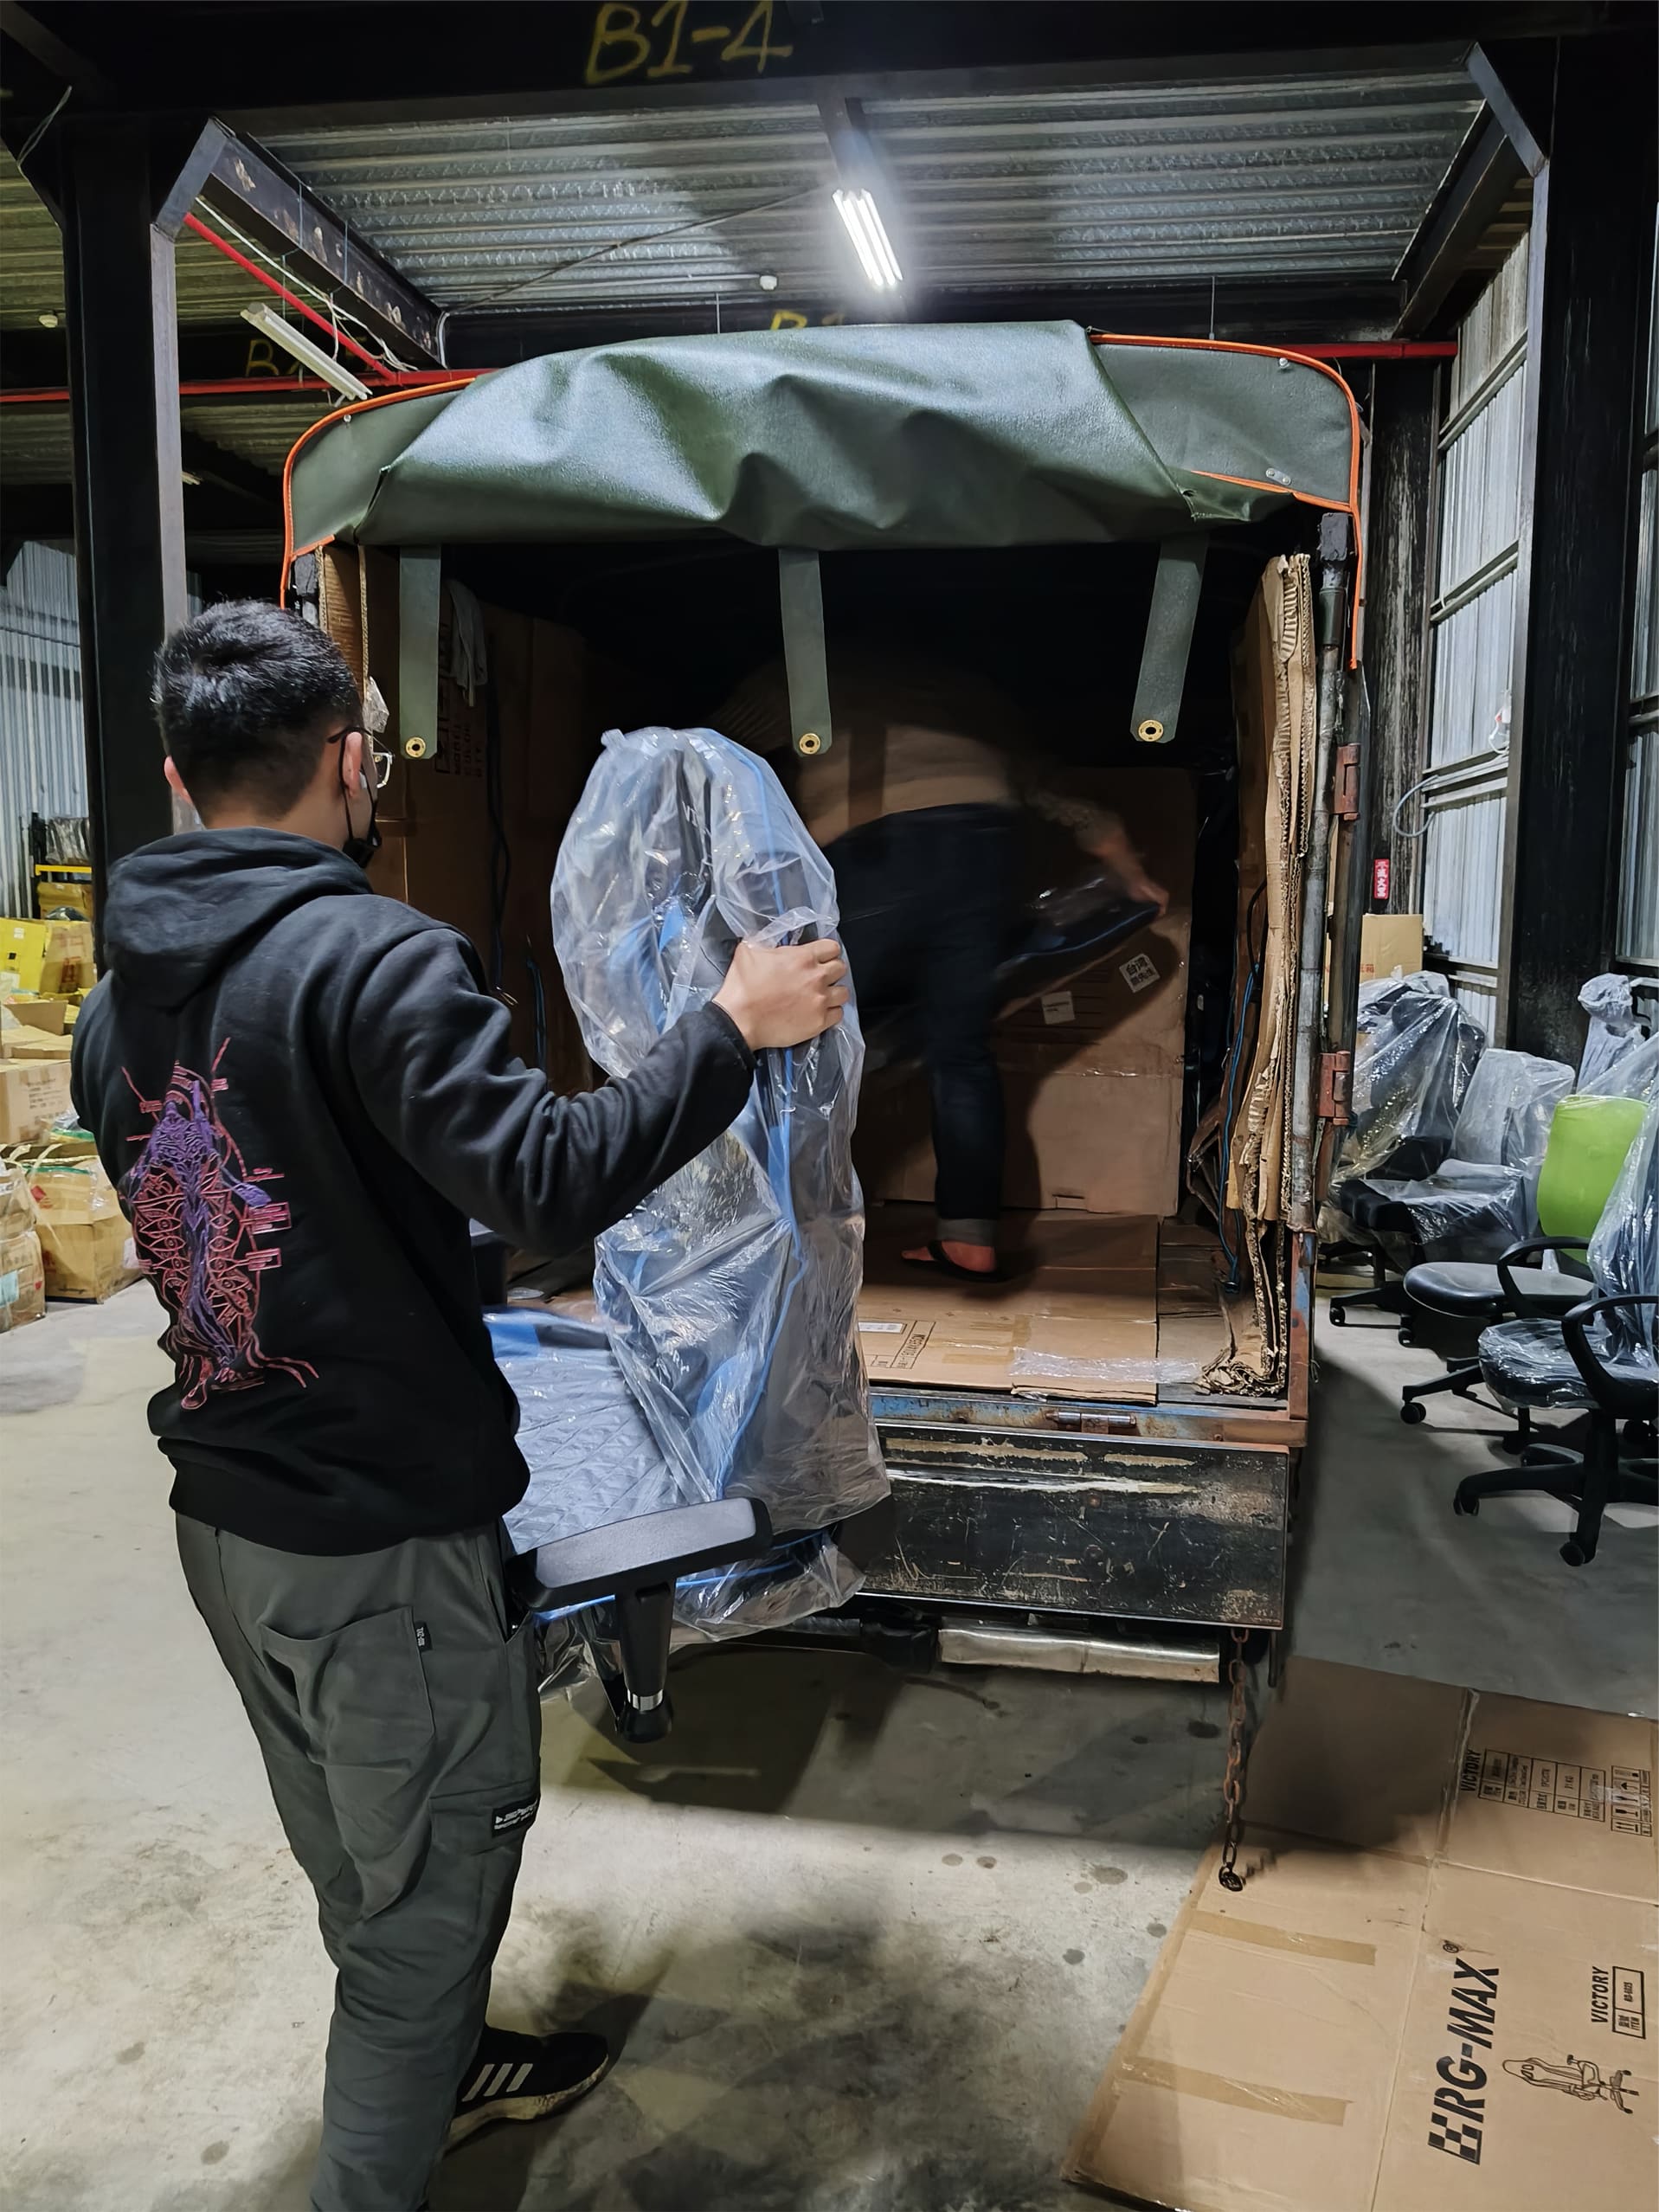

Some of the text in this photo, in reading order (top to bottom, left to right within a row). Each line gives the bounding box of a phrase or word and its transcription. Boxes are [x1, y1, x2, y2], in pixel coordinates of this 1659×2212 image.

[586, 0, 794, 84] B1-4
[1460, 1748, 1482, 1792] VICTORY
[1591, 1965, 1609, 2022] VICTORY
